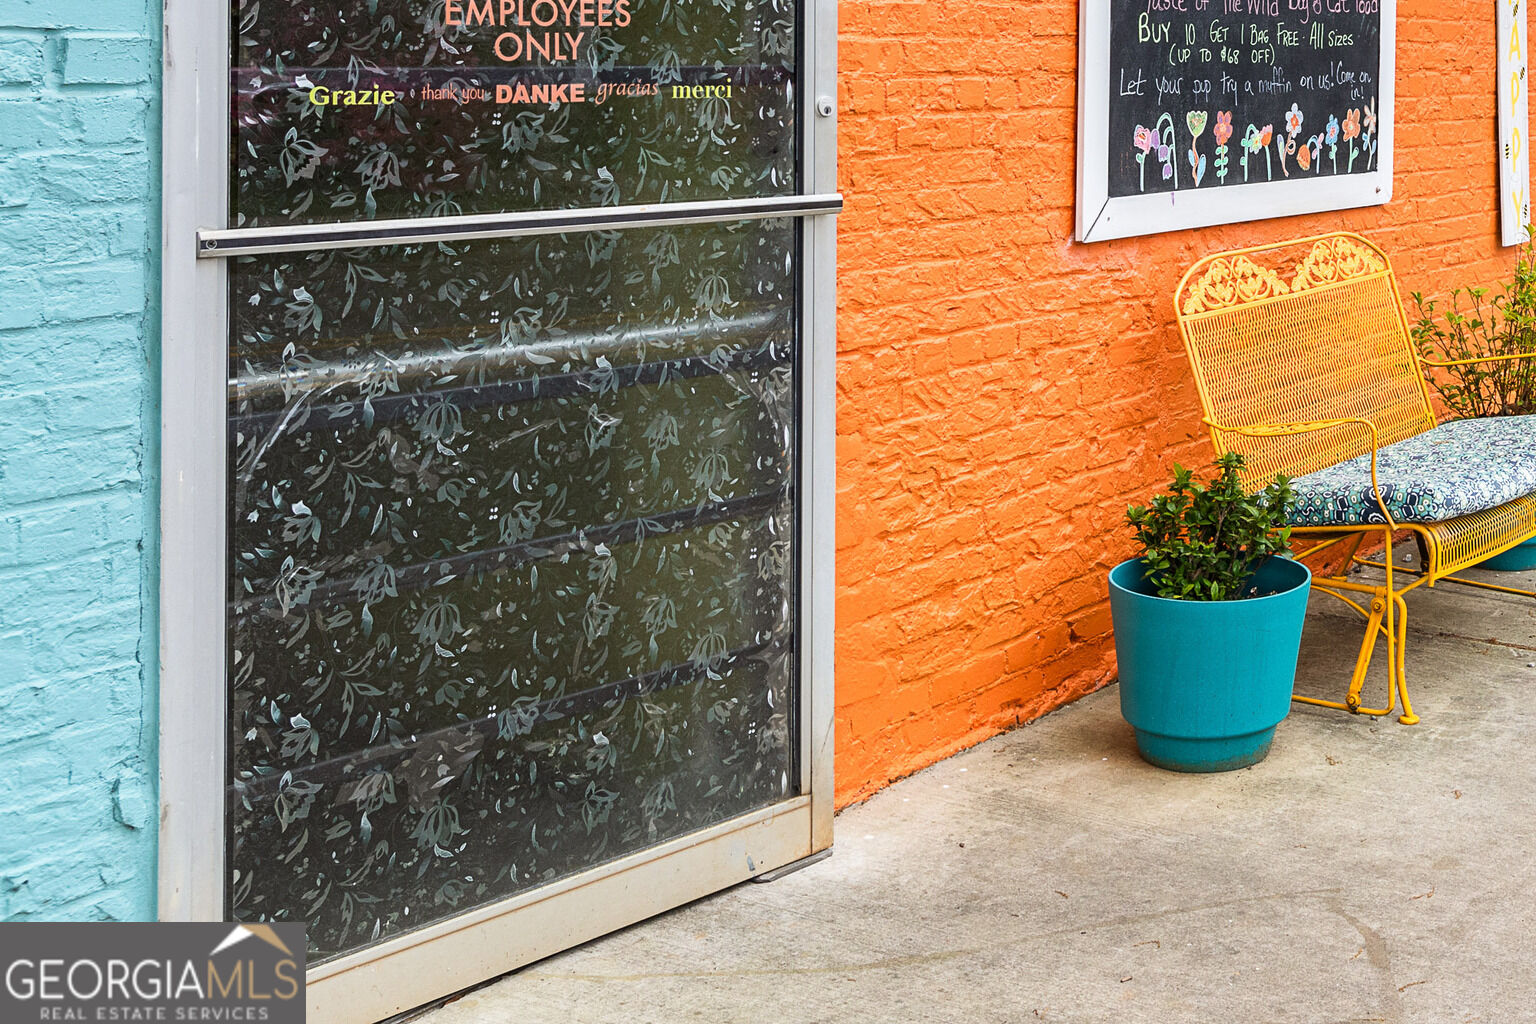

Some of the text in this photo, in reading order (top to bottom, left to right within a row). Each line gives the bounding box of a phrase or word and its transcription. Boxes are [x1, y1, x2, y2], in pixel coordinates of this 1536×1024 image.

[1138, 12, 1171, 44] BUY
[1185, 24, 1196, 45] 10
[1209, 19, 1230, 43] GET
[1277, 21, 1300, 46] FREE
[494, 32, 585, 62] ONLY
[1169, 43, 1275, 66] (UP TO $68 OFF)
[309, 77, 732, 106] Grazie thank you DANKE gracias merci
[1119, 60, 1372, 106] Let your pup try a muffin on us! Come on
